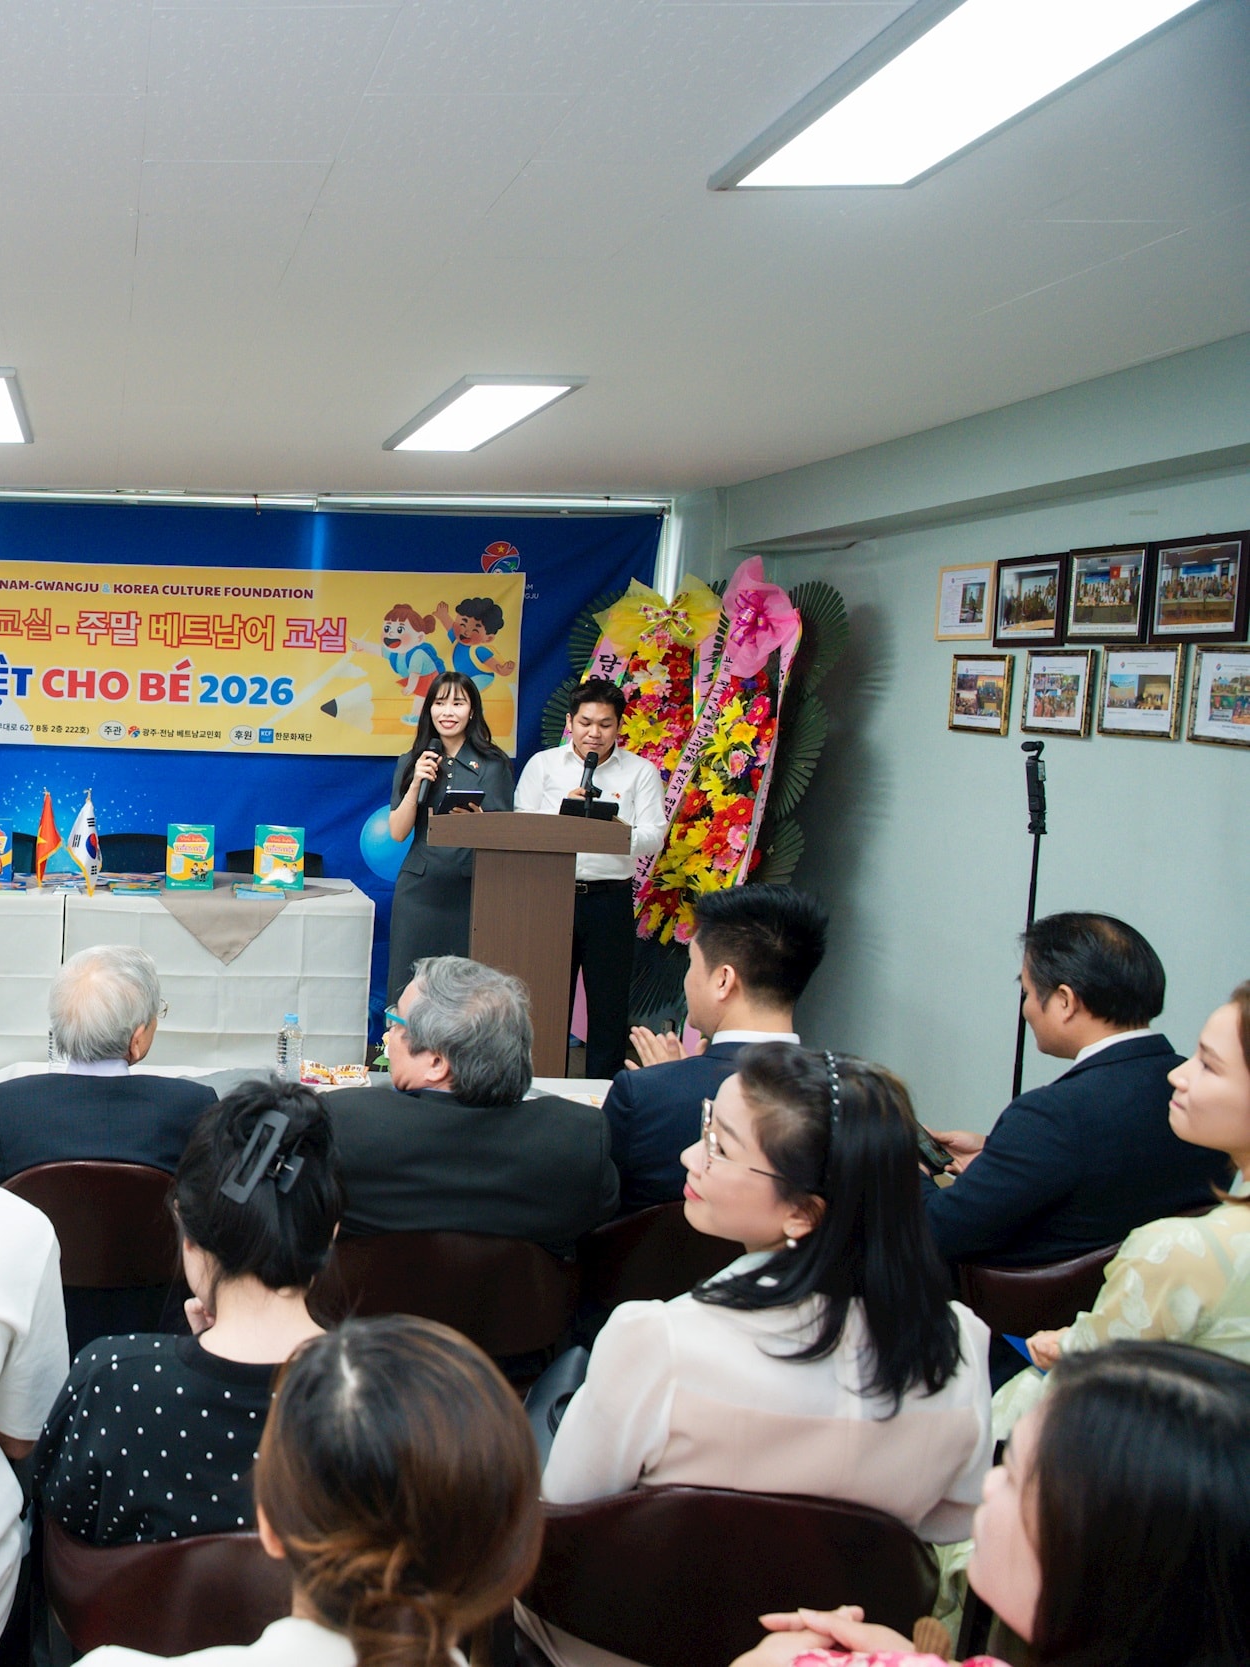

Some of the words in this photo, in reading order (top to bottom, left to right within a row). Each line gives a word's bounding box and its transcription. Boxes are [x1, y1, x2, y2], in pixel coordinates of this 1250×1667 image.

[102, 583, 111, 594] &
[113, 584, 159, 595] KOREA
[162, 585, 221, 597] CULTURE
[224, 586, 314, 599] FOUNDATION
[76, 611, 142, 647] 주말
[149, 612, 275, 651] 베트남어
[283, 617, 347, 653] 교실
[42, 668, 129, 701] CHO
[139, 658, 192, 702] BÉ
[199, 674, 294, 706] 2026
[19, 724, 34, 732] 627
[36, 724, 48, 733] B동
[51, 725, 63, 734] 2층
[65, 726, 90, 735] 222호)
[104, 726, 122, 736] 주관
[176, 729, 222, 739] 베트남교민회
[234, 730, 252, 740] 후원
[275, 732, 312, 742] 한문화재단
